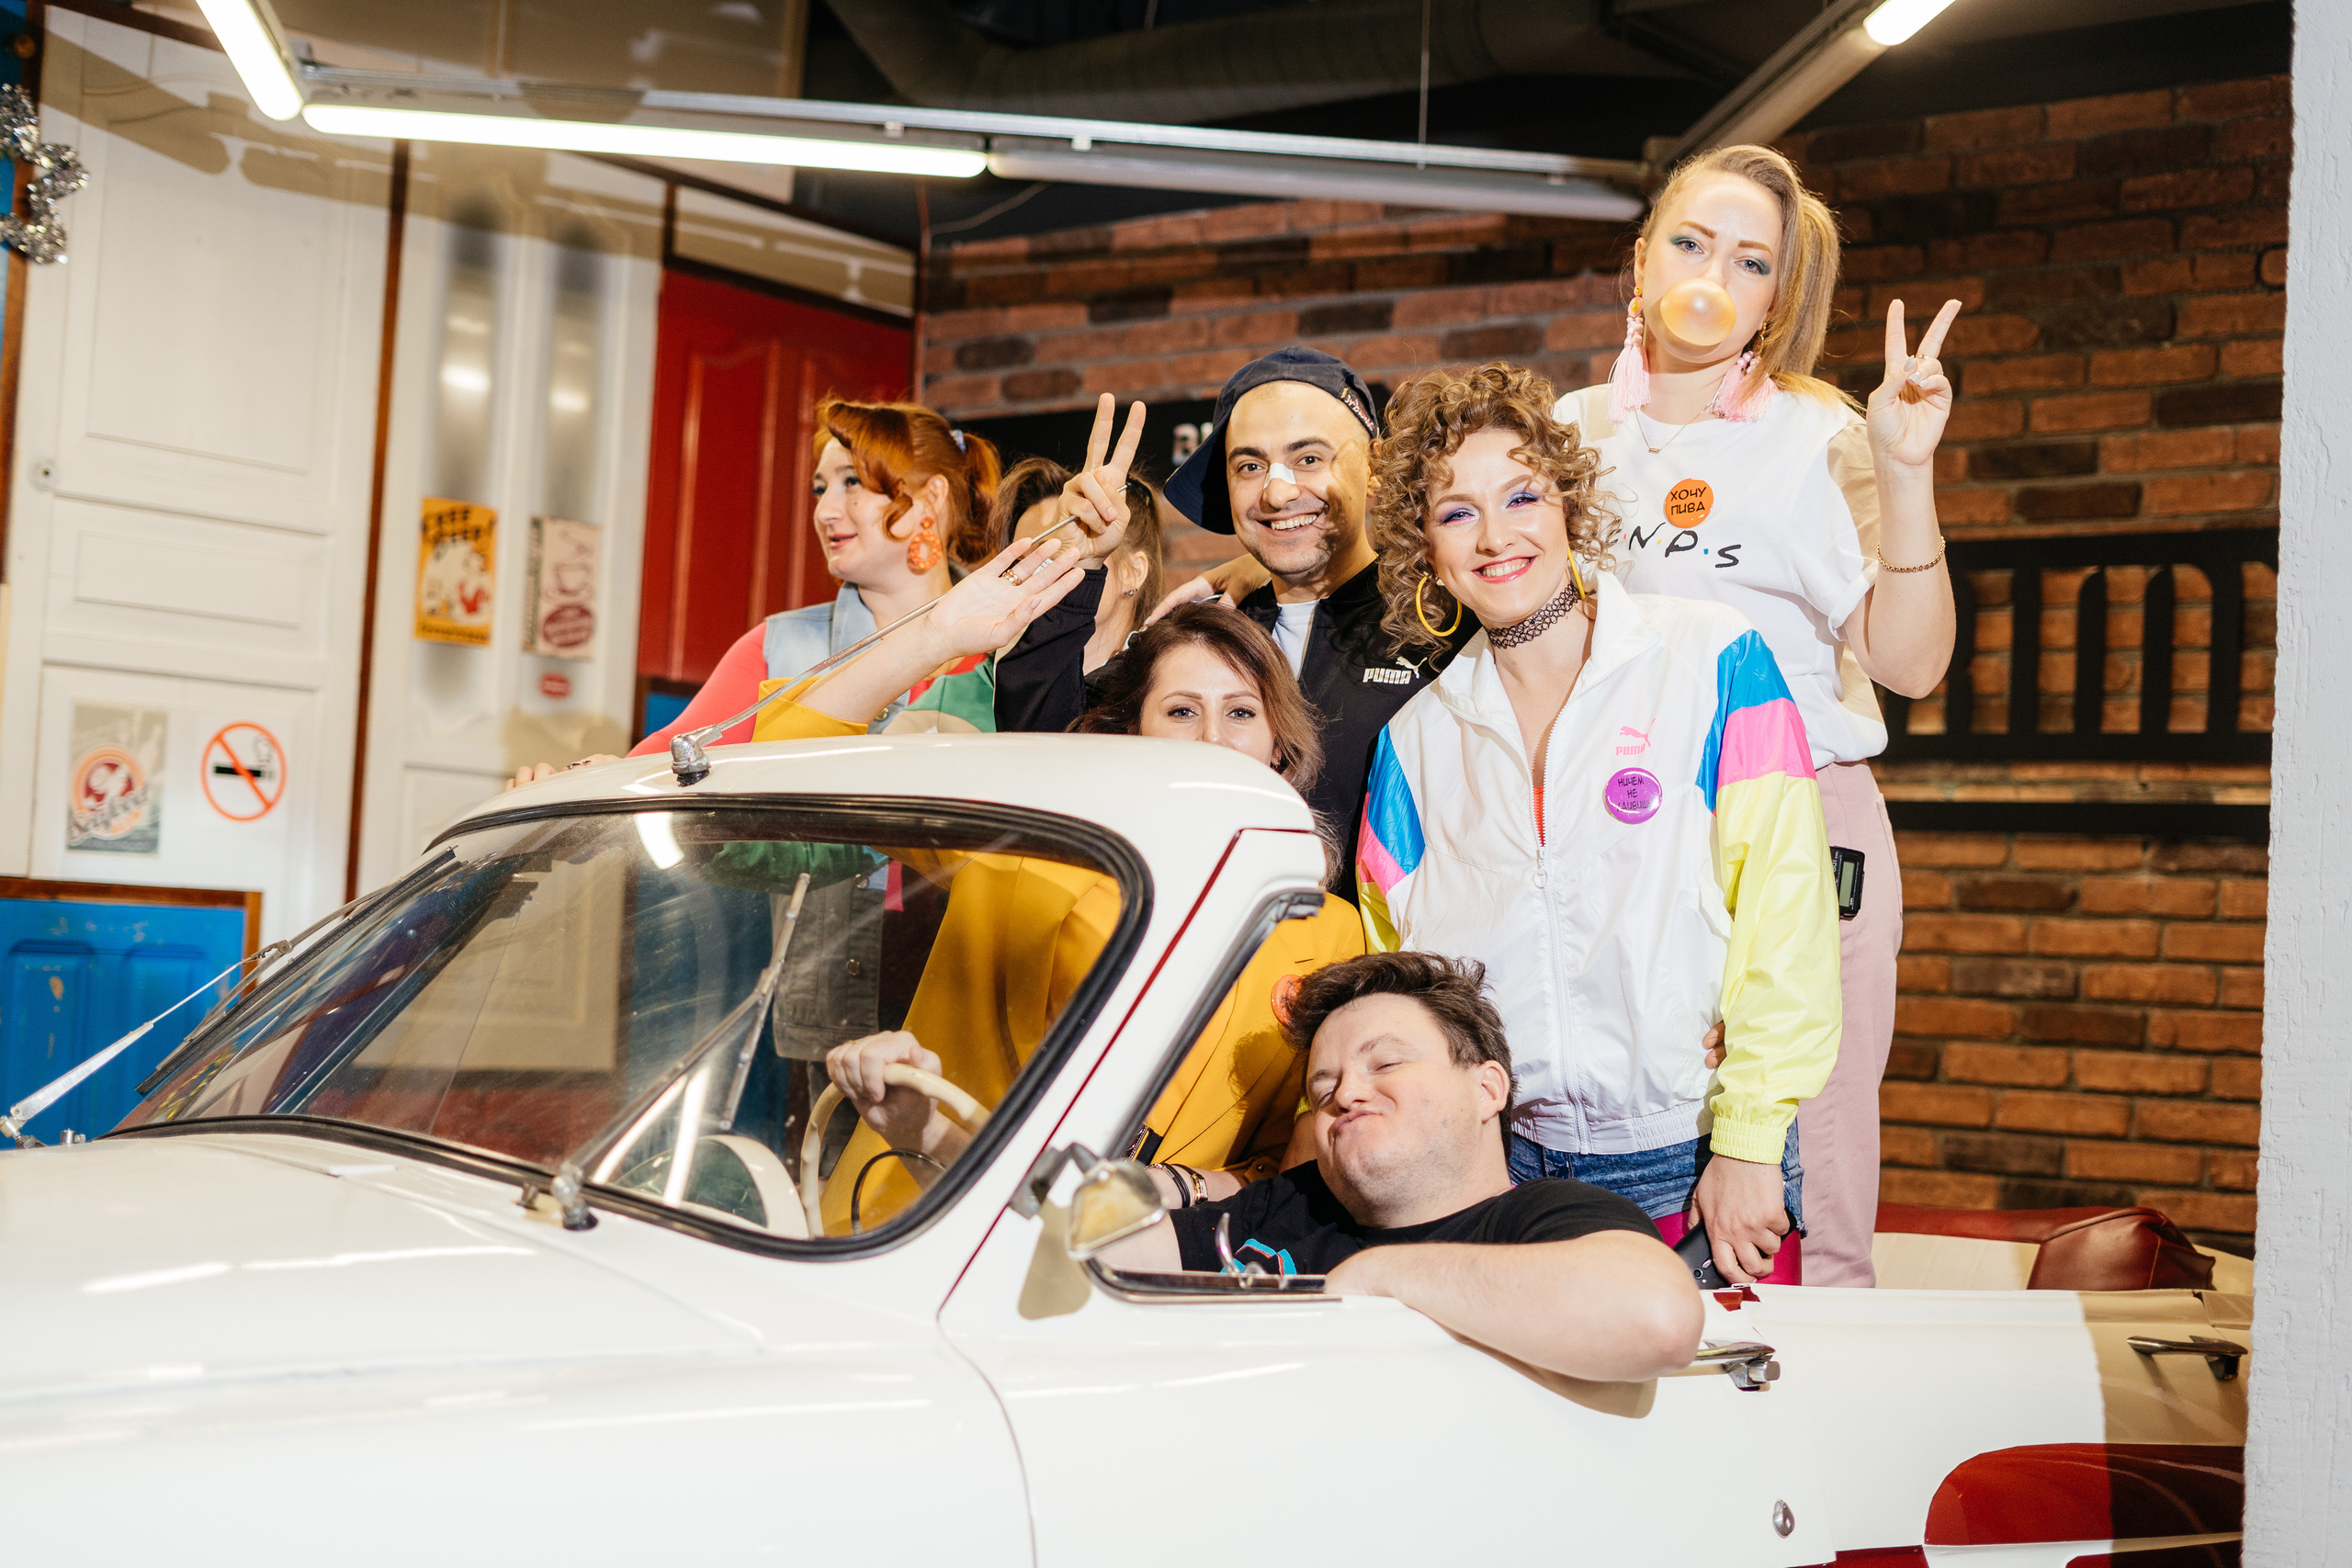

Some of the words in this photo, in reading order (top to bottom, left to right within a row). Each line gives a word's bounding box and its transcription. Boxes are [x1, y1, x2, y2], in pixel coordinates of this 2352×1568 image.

[1670, 487, 1707, 502] ХОЧУ
[1670, 501, 1706, 515] ПИВА
[1363, 667, 1412, 684] PUMA
[1618, 776, 1645, 787] НИЧЕМ
[1627, 788, 1637, 798] НЕ
